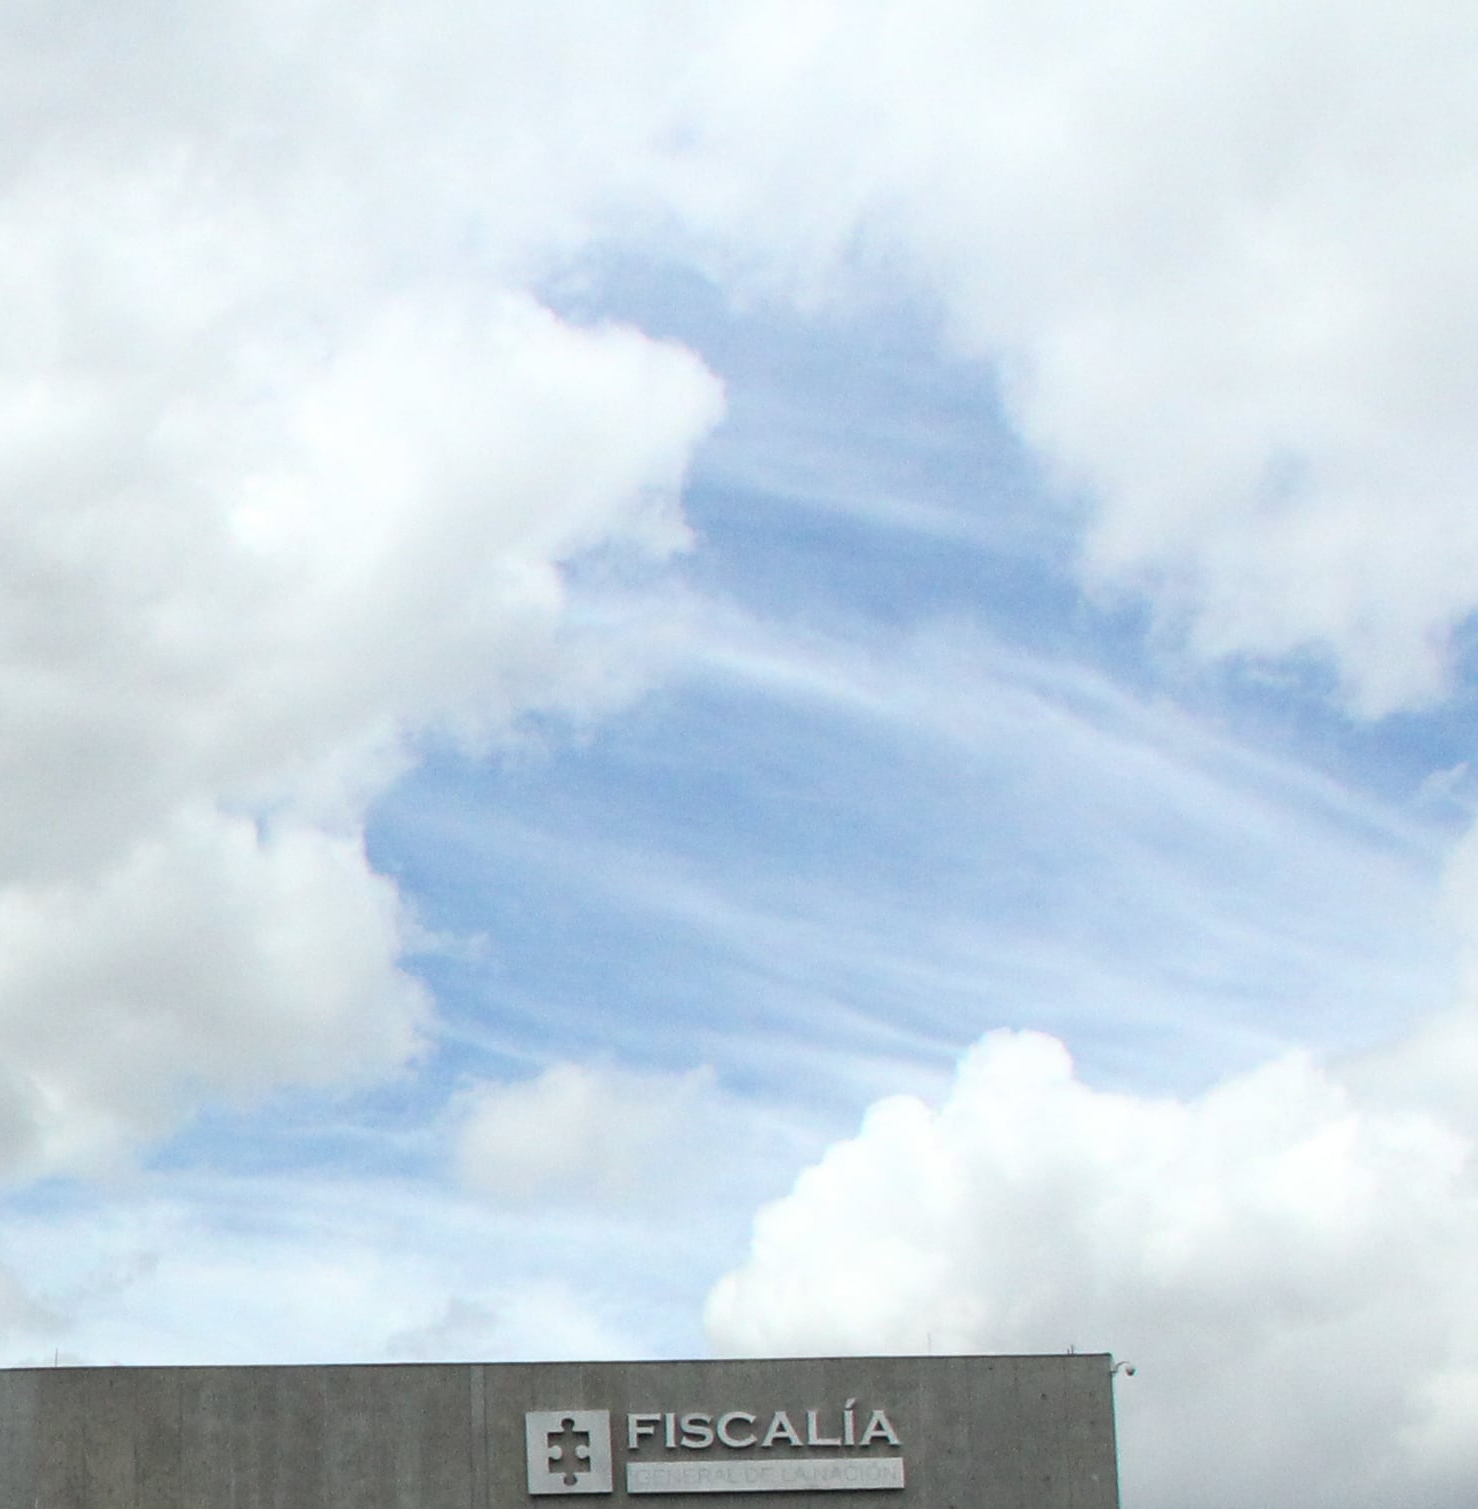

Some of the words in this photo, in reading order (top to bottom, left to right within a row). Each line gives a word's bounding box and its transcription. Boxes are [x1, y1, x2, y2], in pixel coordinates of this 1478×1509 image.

[627, 1398, 901, 1449] FISCALÍA
[635, 1467, 738, 1486] GENERAL
[744, 1467, 773, 1484] DE
[782, 1465, 808, 1483] LA
